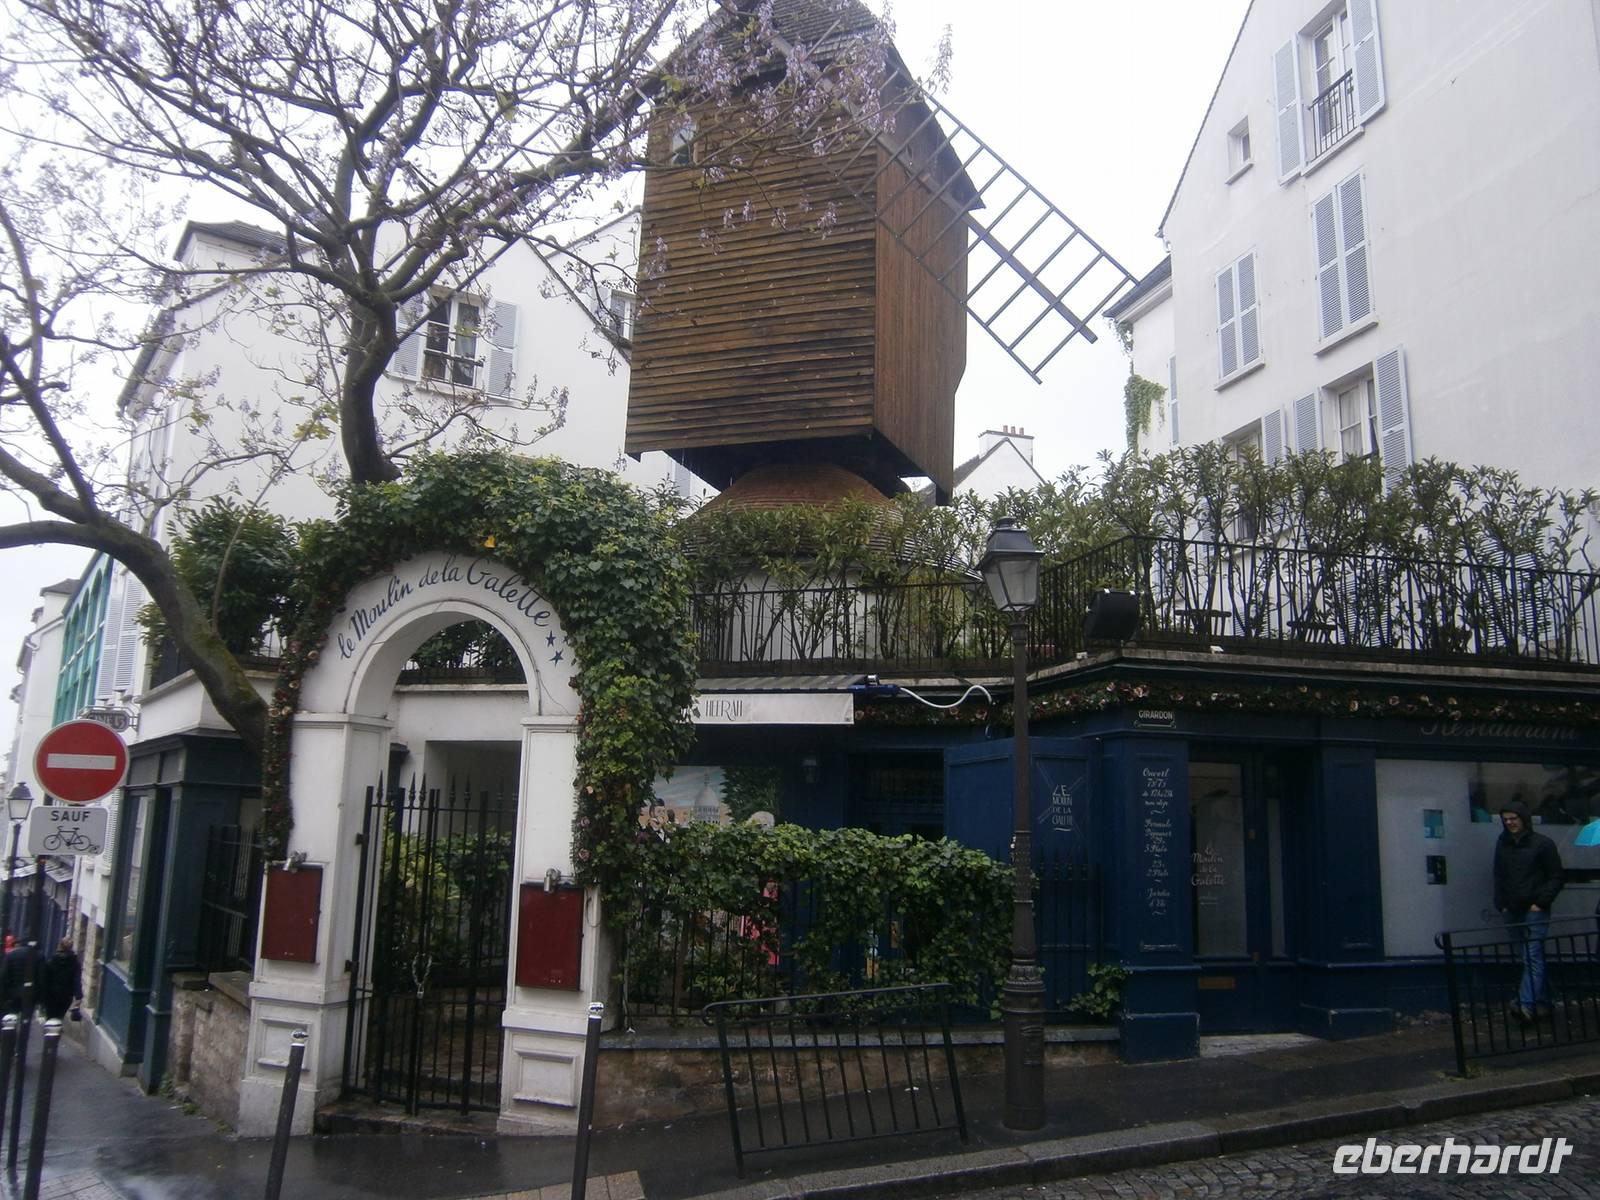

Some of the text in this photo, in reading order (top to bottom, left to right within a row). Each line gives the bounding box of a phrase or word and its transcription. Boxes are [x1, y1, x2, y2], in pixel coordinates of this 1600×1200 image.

[338, 632, 356, 660] le
[351, 577, 414, 641] Moulin
[466, 557, 552, 627] Galette
[1138, 709, 1174, 720] GIRARDON
[1052, 784, 1071, 796] LE
[50, 809, 91, 823] SAUF
